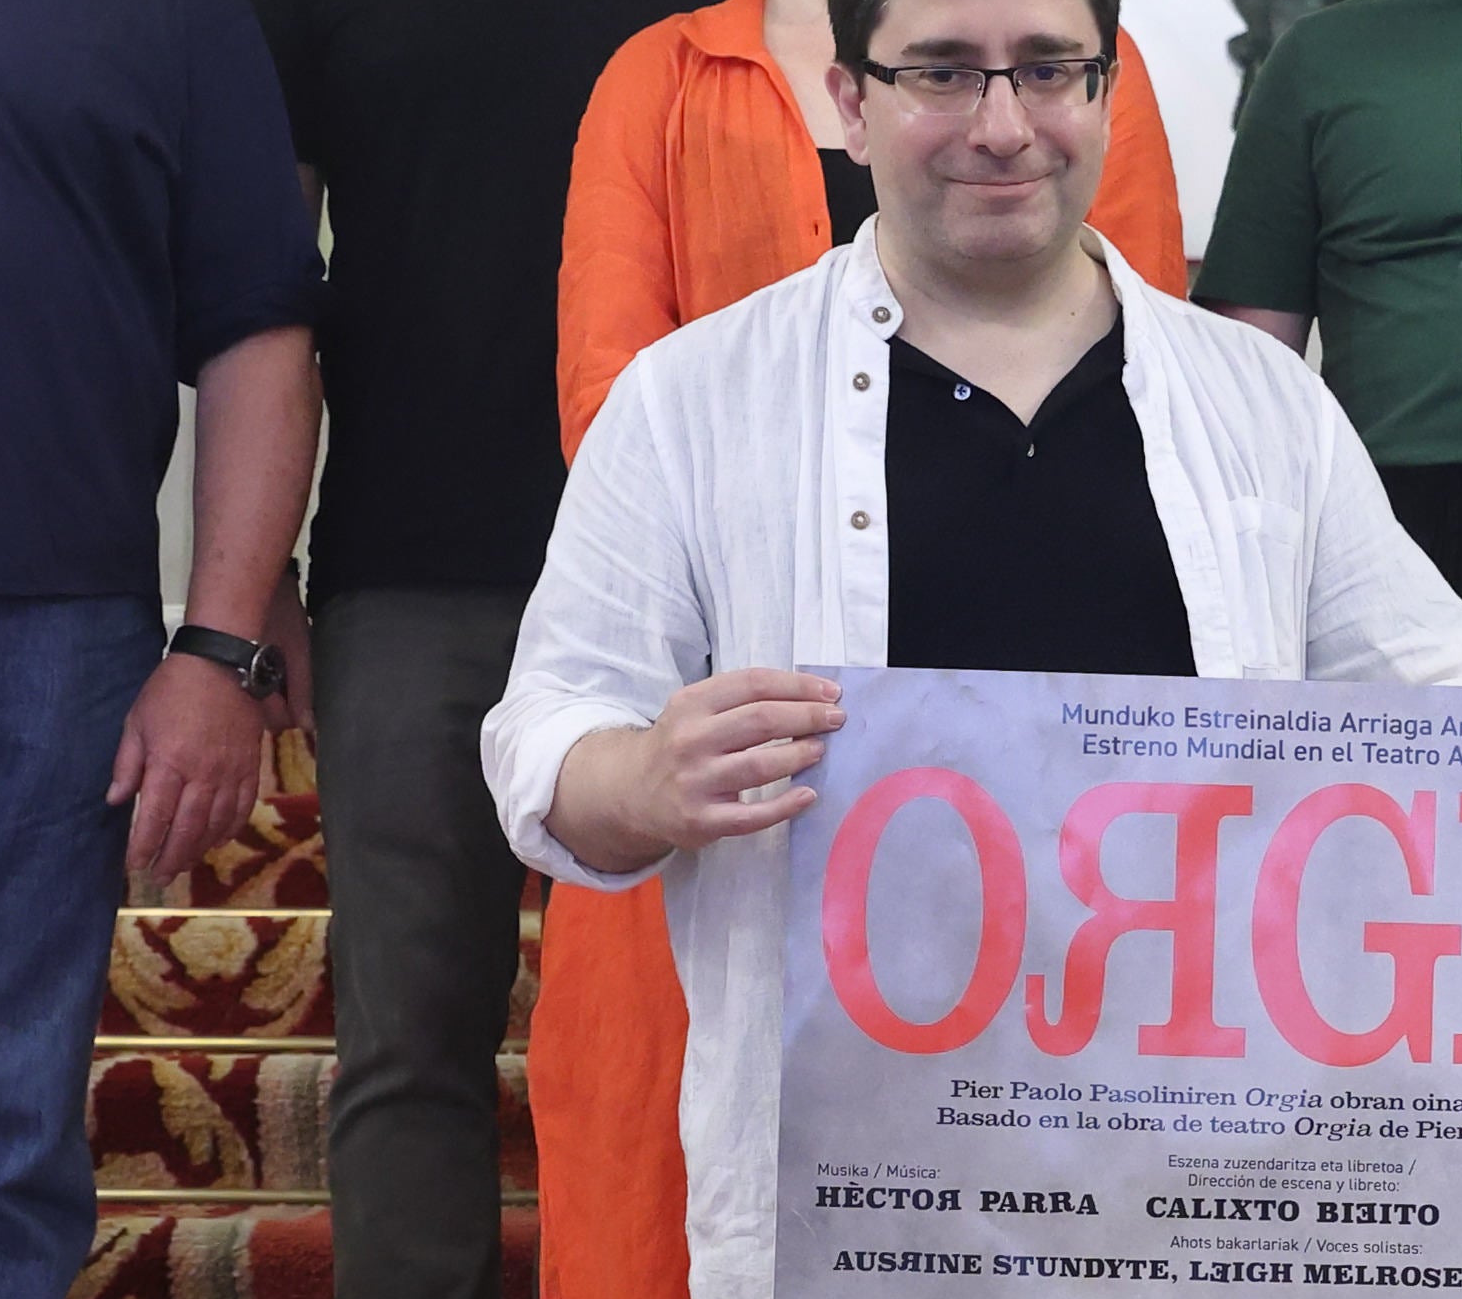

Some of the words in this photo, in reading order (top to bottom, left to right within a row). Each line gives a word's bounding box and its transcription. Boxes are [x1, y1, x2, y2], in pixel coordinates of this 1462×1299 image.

[1061, 703, 1175, 727] Munduko
[1184, 707, 1331, 732] Estreinaldia
[1339, 712, 1433, 740] Arriaga
[1082, 733, 1178, 756] Estreno
[1187, 737, 1286, 761] Mundial
[1293, 744, 1323, 762] en
[1331, 742, 1353, 762] el
[1361, 742, 1441, 766] Teatro
[950, 1079, 1004, 1100] Pier
[1009, 1081, 1082, 1102] Paolo
[1089, 1083, 1237, 1106] Pasoliniren
[1245, 1087, 1323, 1113] Orgia
[1330, 1091, 1406, 1111] obran
[936, 1106, 1032, 1128] Basado
[1038, 1113, 1070, 1129] en
[1075, 1111, 1101, 1130] la
[1107, 1112, 1165, 1132] obra
[1172, 1114, 1203, 1133] de
[1210, 1116, 1286, 1135] teatro
[1294, 1116, 1373, 1142] Orgia
[1379, 1119, 1409, 1138] de
[817, 1163, 869, 1178] Musika
[886, 1163, 941, 1179] Música:
[1168, 1155, 1219, 1170] Eszena
[1223, 1156, 1317, 1172] zuzendaritza
[1320, 1160, 1343, 1172] eta
[1347, 1159, 1403, 1174] libretoa
[1188, 1173, 1255, 1188] Dirección
[1259, 1174, 1277, 1189] de
[1281, 1178, 1332, 1191] escena
[1336, 1180, 1345, 1194] y
[1348, 1177, 1400, 1193] libreto:
[979, 1190, 1099, 1215] PARRA
[1145, 1196, 1300, 1222] CALIXTO
[1170, 1236, 1212, 1250] Ahots
[1216, 1237, 1299, 1252] bakarlariak
[1316, 1239, 1359, 1253] Voces
[1363, 1240, 1423, 1255] solistas:
[992, 1254, 1178, 1283] STUNDYTE,
